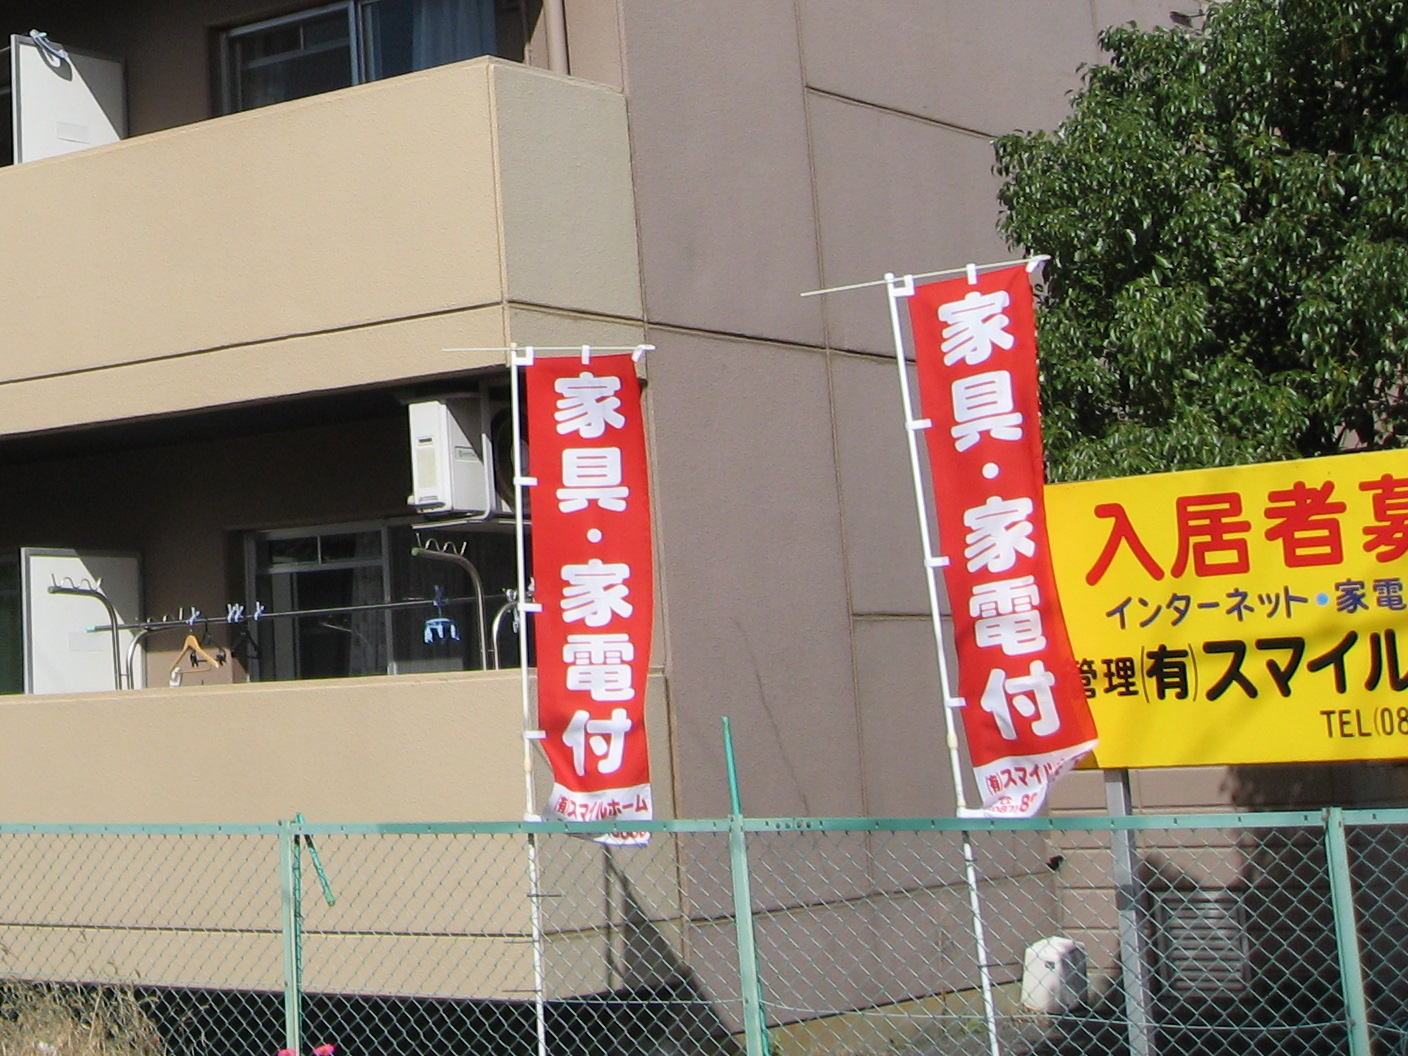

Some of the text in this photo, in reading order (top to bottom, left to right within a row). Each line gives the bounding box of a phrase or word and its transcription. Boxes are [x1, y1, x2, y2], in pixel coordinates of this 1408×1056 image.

[554, 372, 635, 777] 家具・家電付
[938, 291, 1061, 741] 家具・家電付
